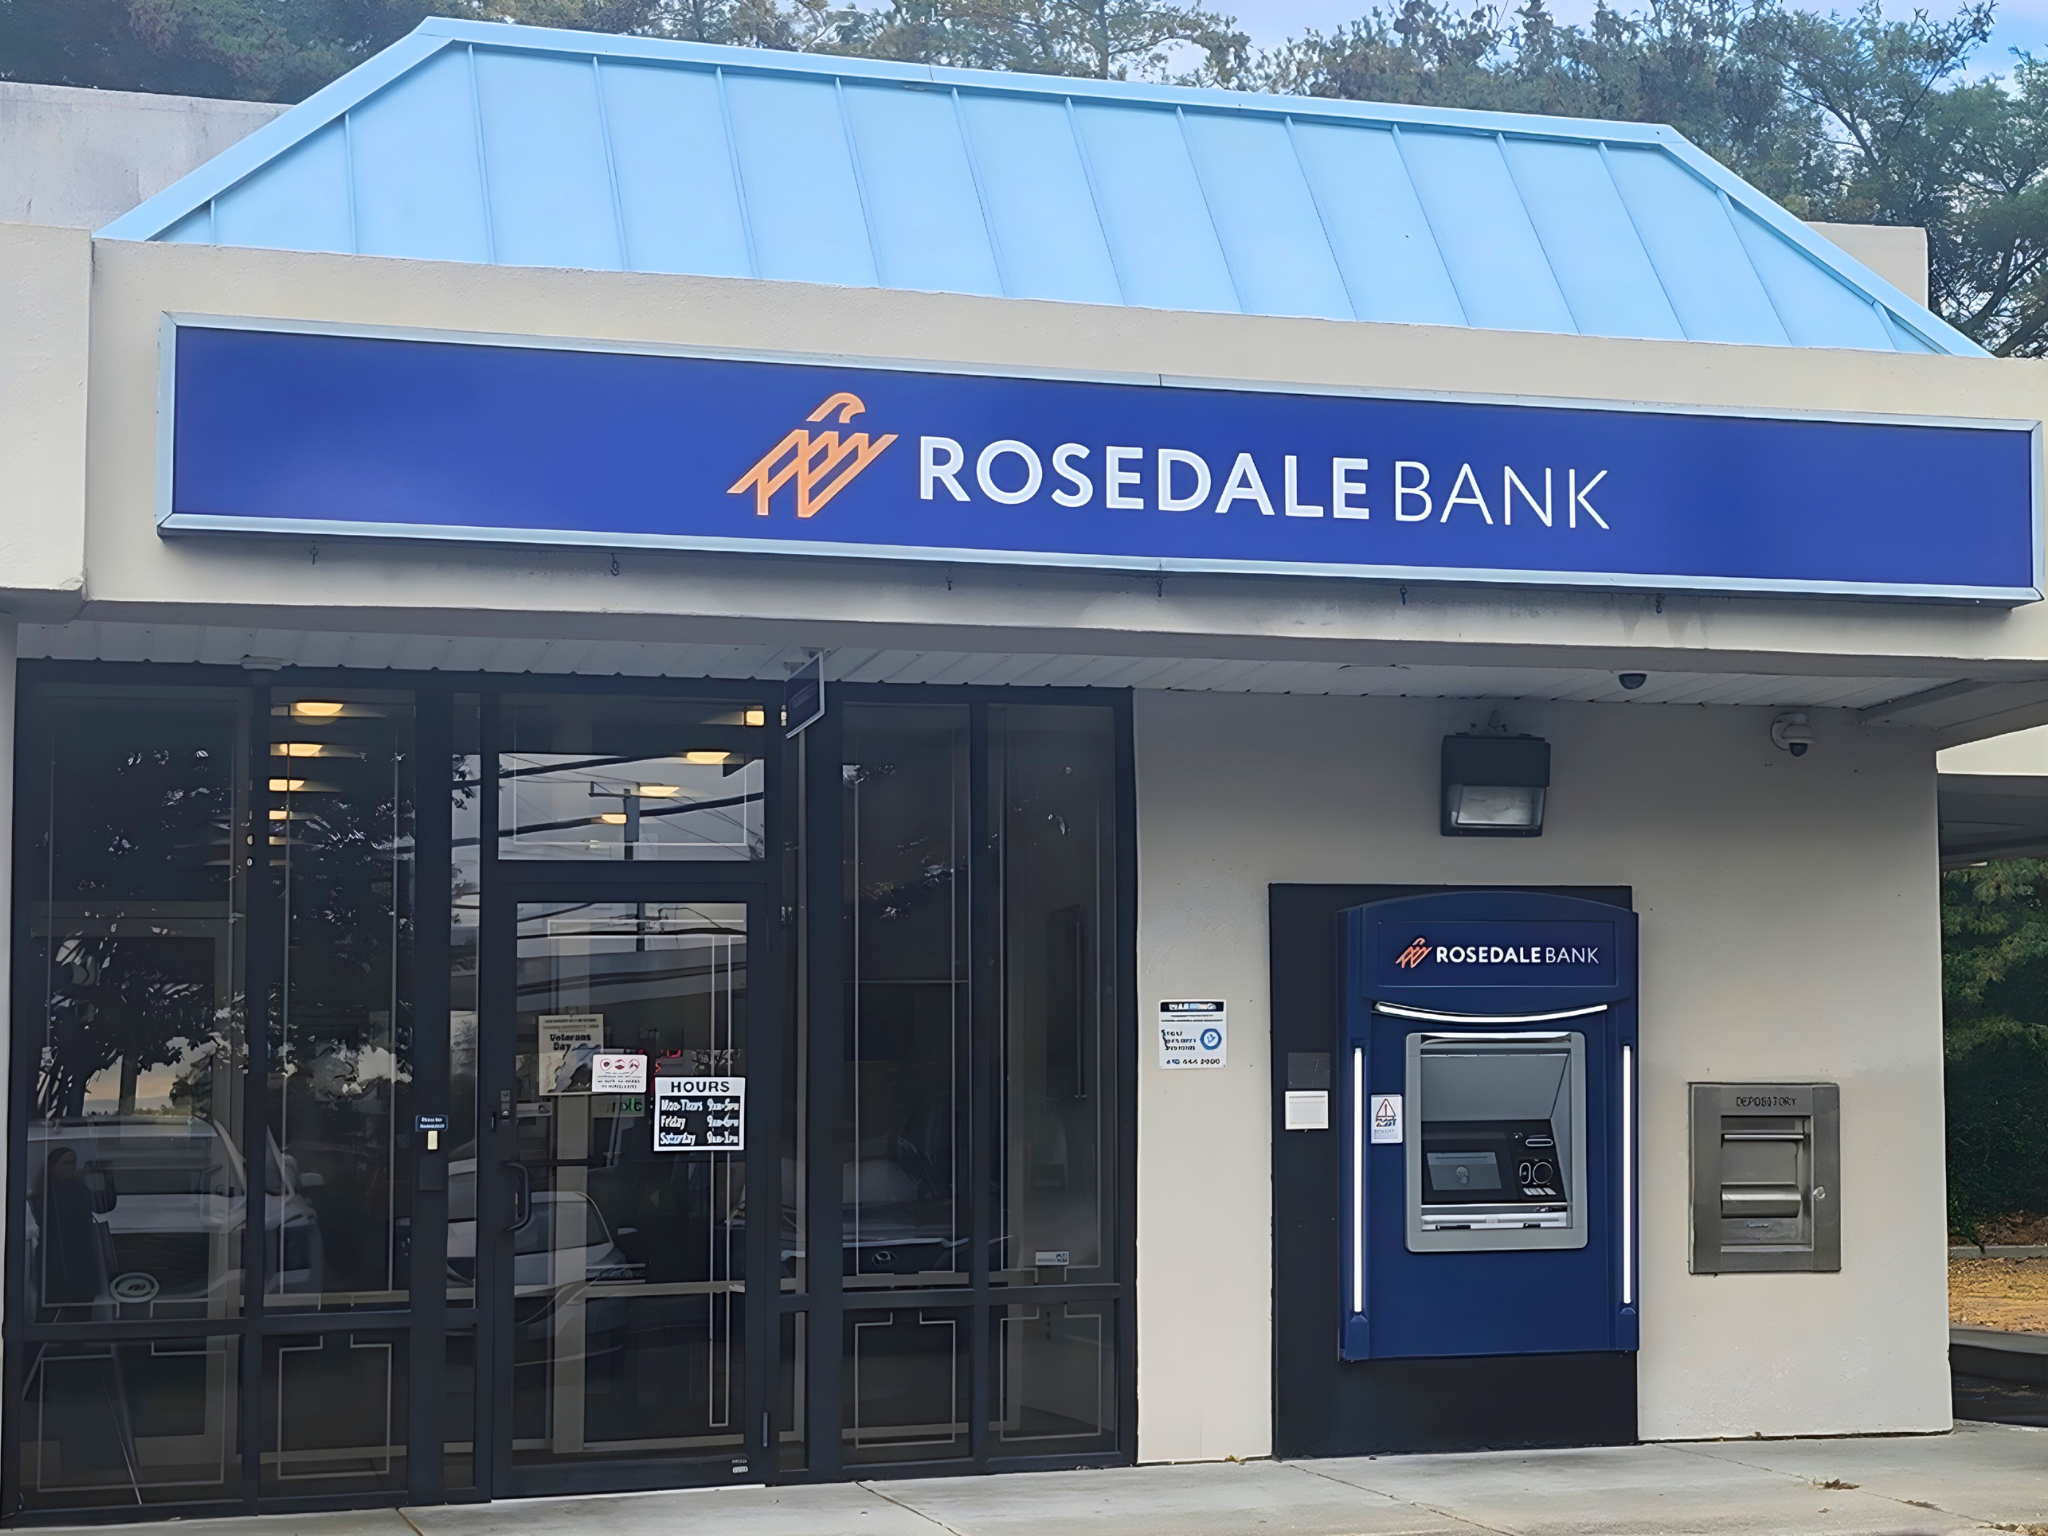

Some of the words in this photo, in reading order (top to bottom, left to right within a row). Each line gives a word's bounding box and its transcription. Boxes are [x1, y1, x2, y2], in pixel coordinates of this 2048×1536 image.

[920, 435, 1370, 520] ROSEDALE
[1395, 461, 1611, 531] BANK
[1436, 946, 1541, 963] ROSEDALE
[1545, 947, 1600, 964] BANK
[553, 1042, 572, 1051] Day
[670, 1081, 731, 1093] HOURS
